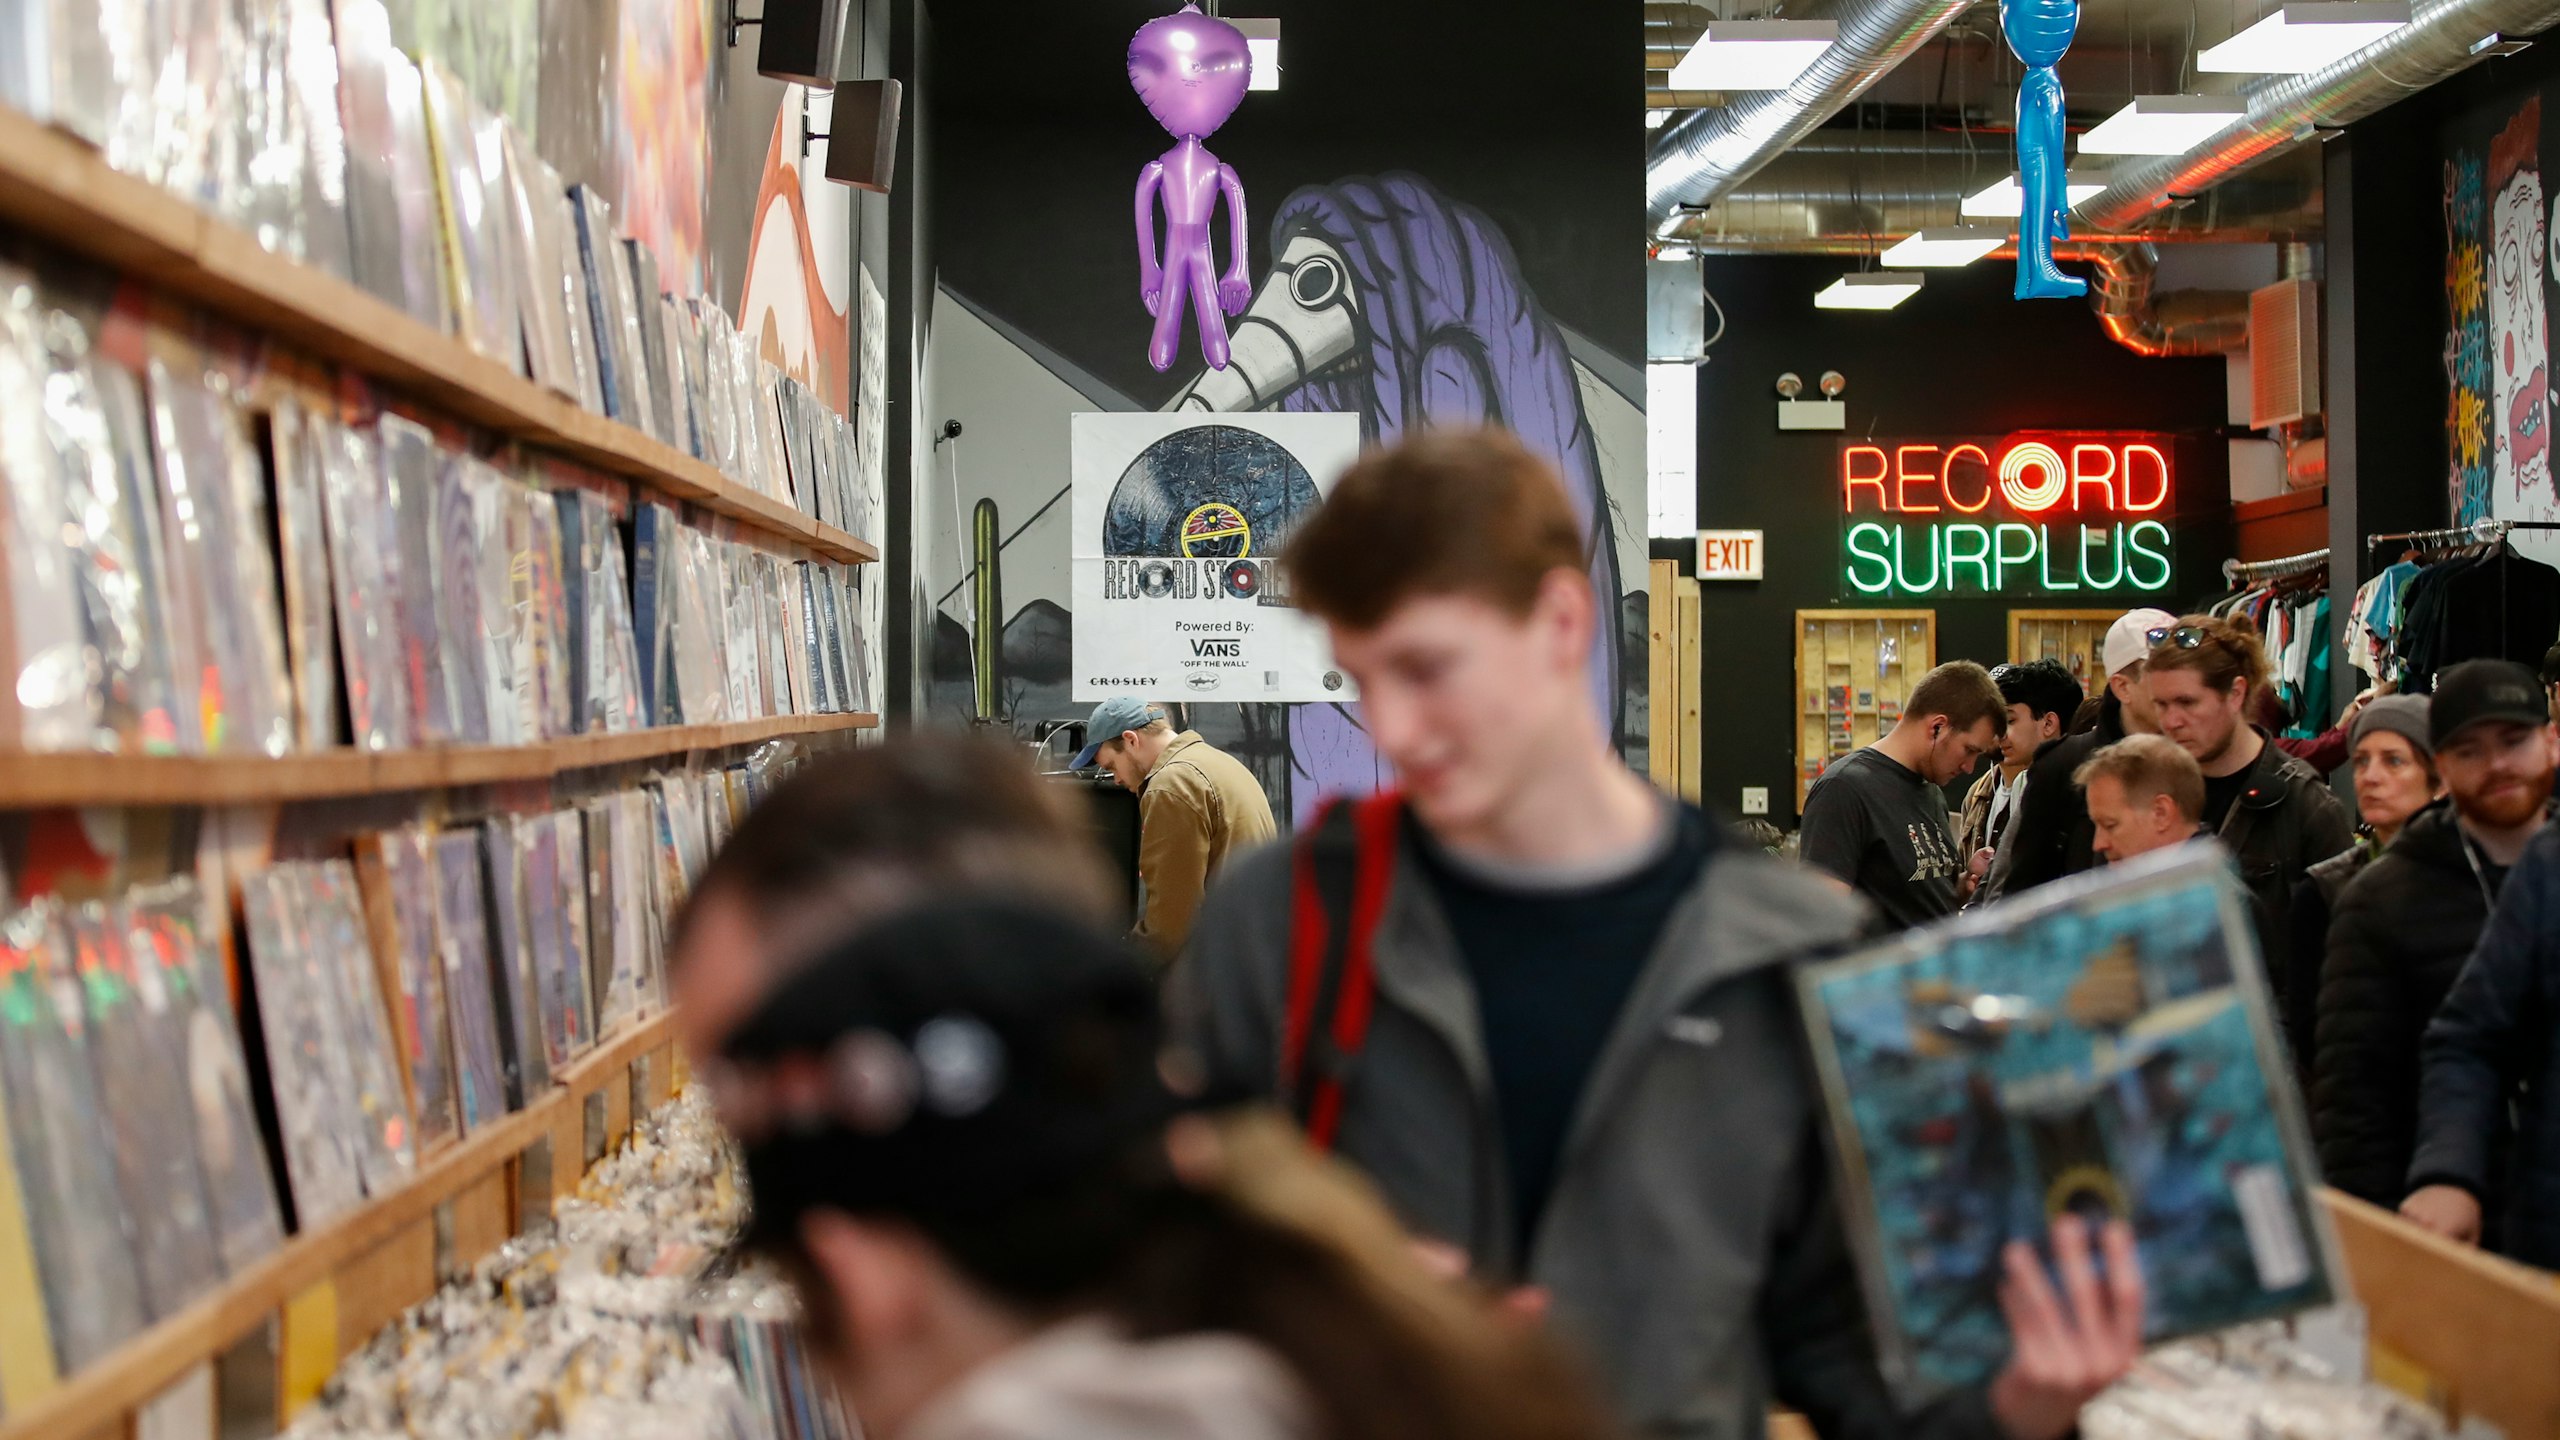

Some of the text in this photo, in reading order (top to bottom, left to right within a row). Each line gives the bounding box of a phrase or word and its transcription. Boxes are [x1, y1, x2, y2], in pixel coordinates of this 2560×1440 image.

[1844, 442, 2168, 513] RECORD
[1705, 538, 1754, 571] EXIT
[1847, 520, 2171, 593] SURPLUS
[1104, 559, 1198, 600] RECORD
[1175, 620, 1254, 634] Powered By:
[1190, 638, 1241, 657] VANS
[1204, 660, 1221, 668] THE
